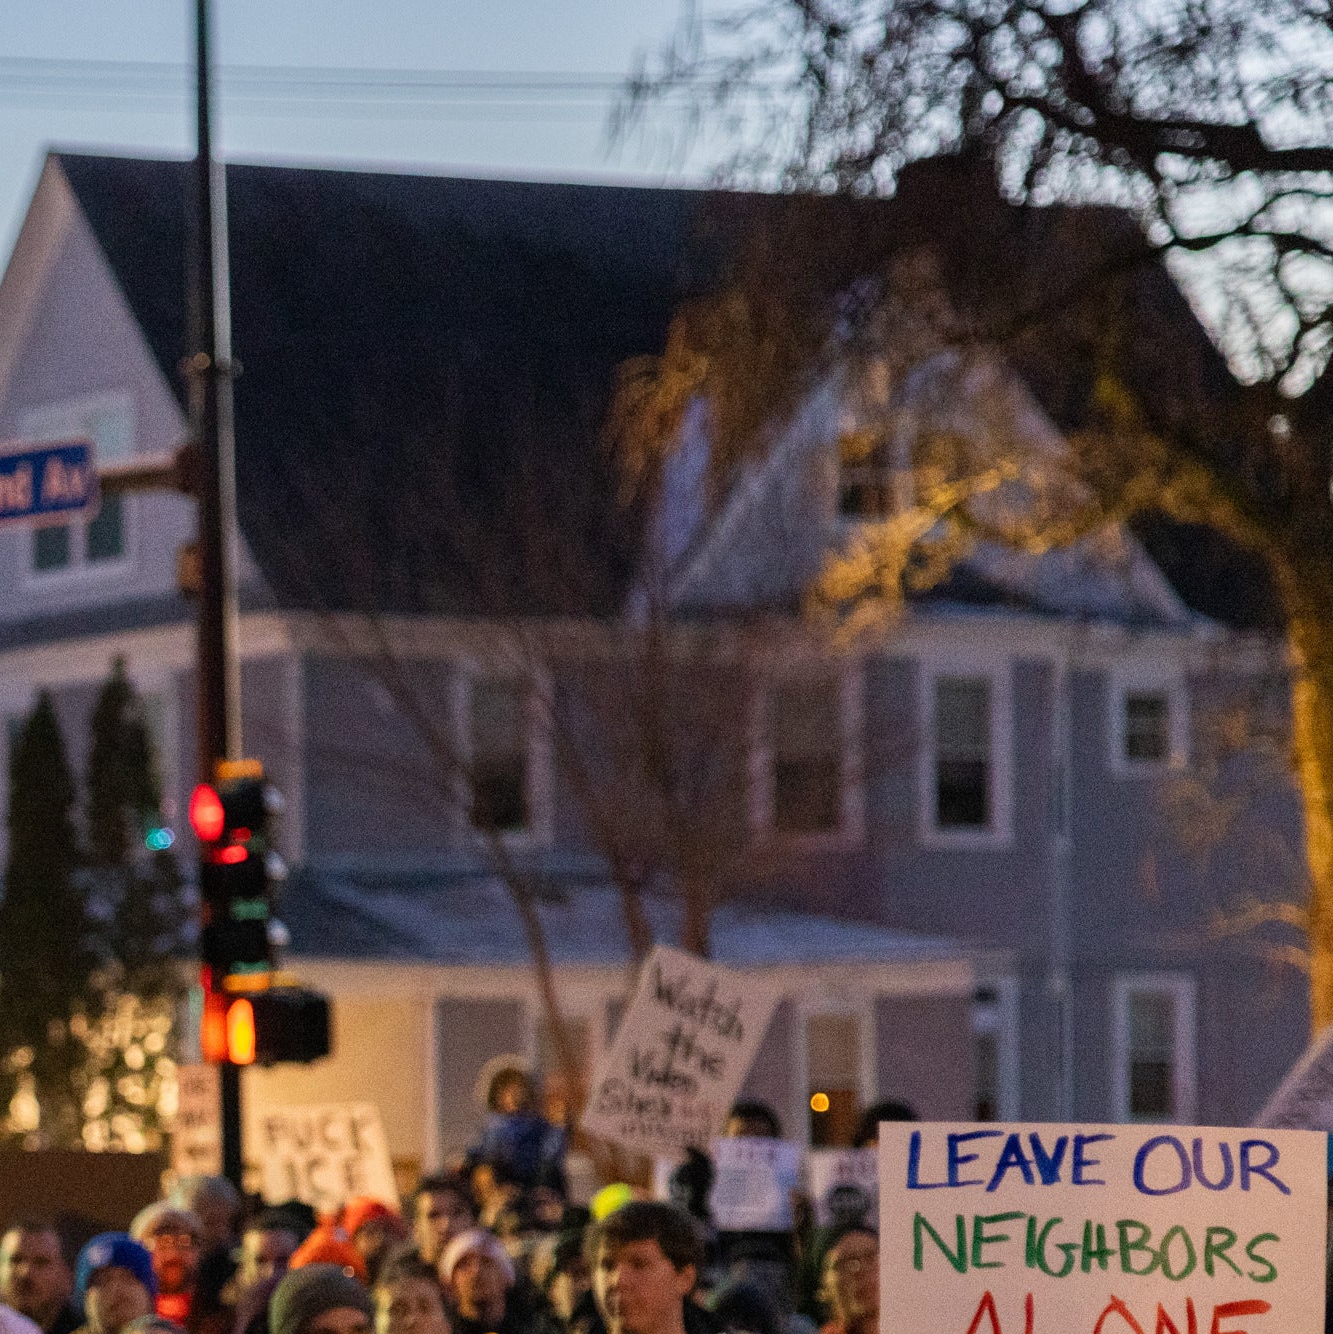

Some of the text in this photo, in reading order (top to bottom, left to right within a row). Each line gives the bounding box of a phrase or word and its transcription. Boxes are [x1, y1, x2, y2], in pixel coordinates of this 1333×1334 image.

[906, 1130, 1117, 1194] LEAVE
[1132, 1134, 1292, 1197] OUR
[912, 1211, 1281, 1284] NEIGHBORS
